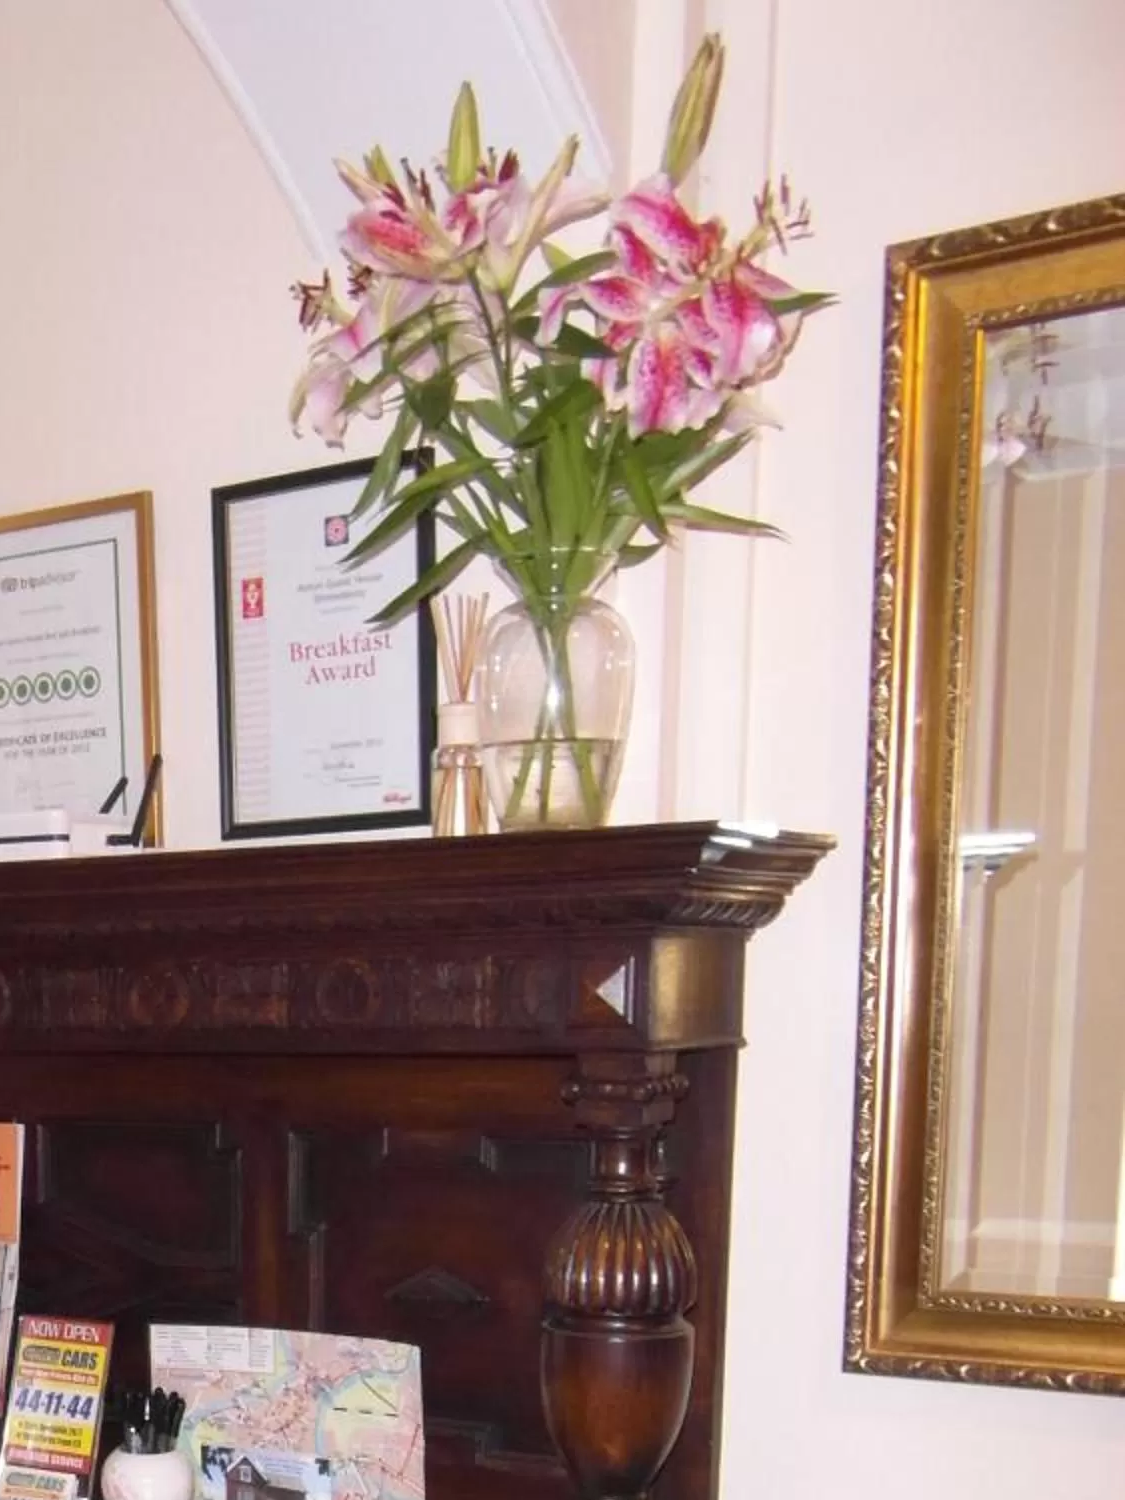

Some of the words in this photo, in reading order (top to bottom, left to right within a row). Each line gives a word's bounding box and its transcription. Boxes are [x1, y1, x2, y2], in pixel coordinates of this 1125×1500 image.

[289, 632, 393, 662] Breakfast
[304, 656, 376, 685] Award
[28, 1319, 62, 1338] NOW
[63, 1323, 101, 1342] OPEN
[60, 1349, 99, 1371] CARS
